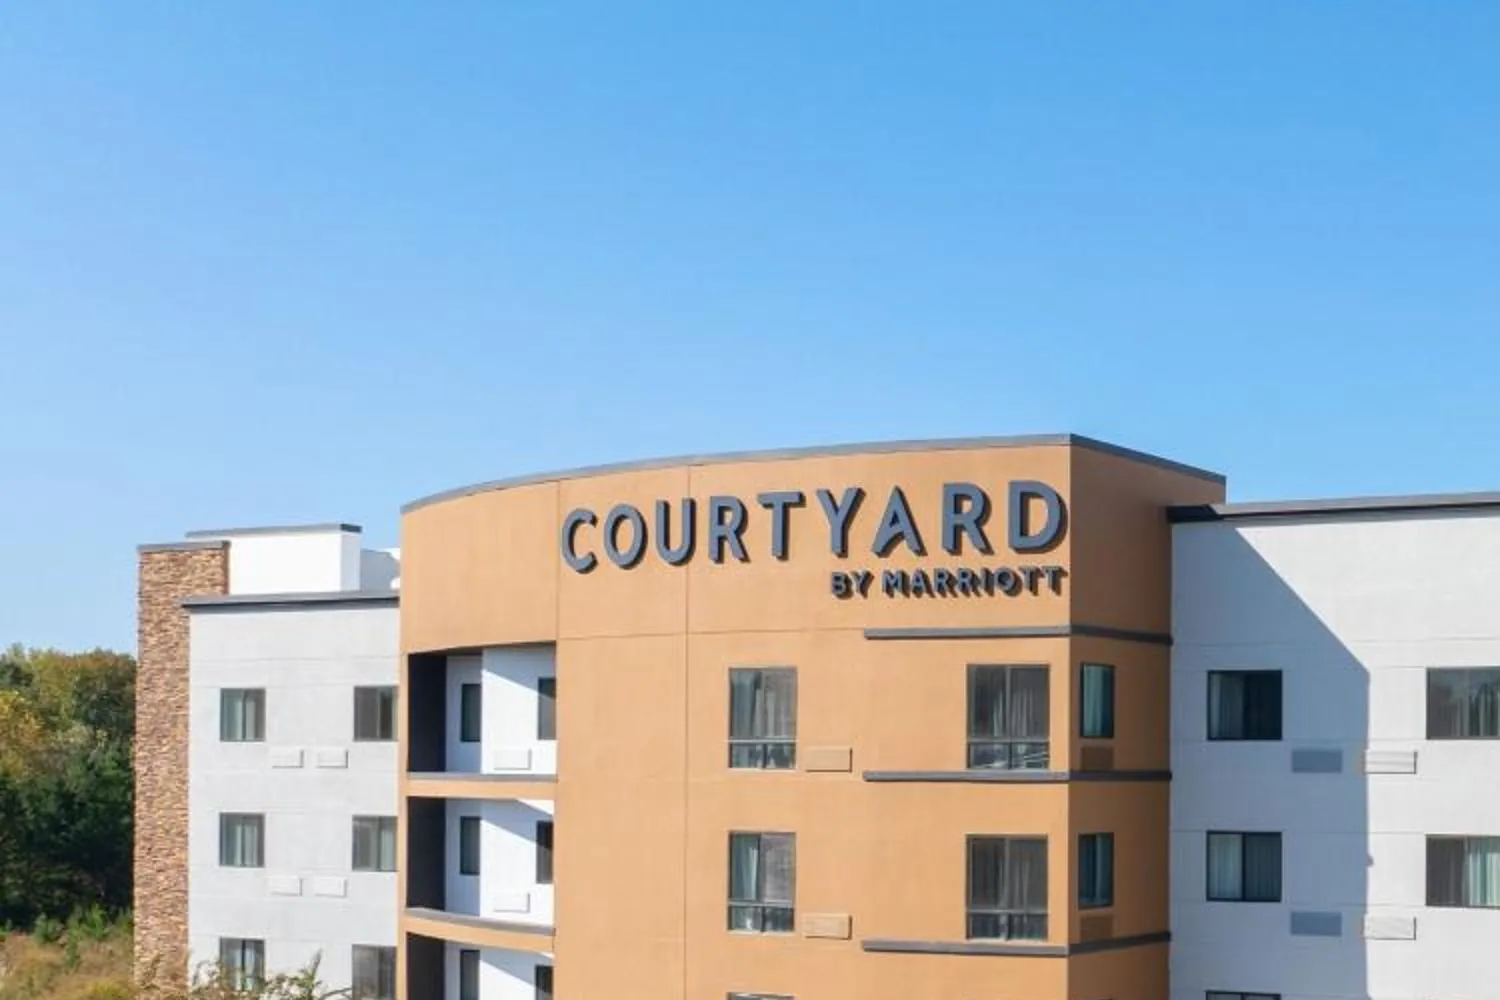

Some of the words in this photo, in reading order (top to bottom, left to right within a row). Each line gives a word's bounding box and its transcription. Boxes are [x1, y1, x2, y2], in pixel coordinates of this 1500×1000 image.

[561, 480, 1068, 573] COURTYARD
[831, 570, 872, 600] BY
[882, 565, 1067, 600] MARRIOTT
